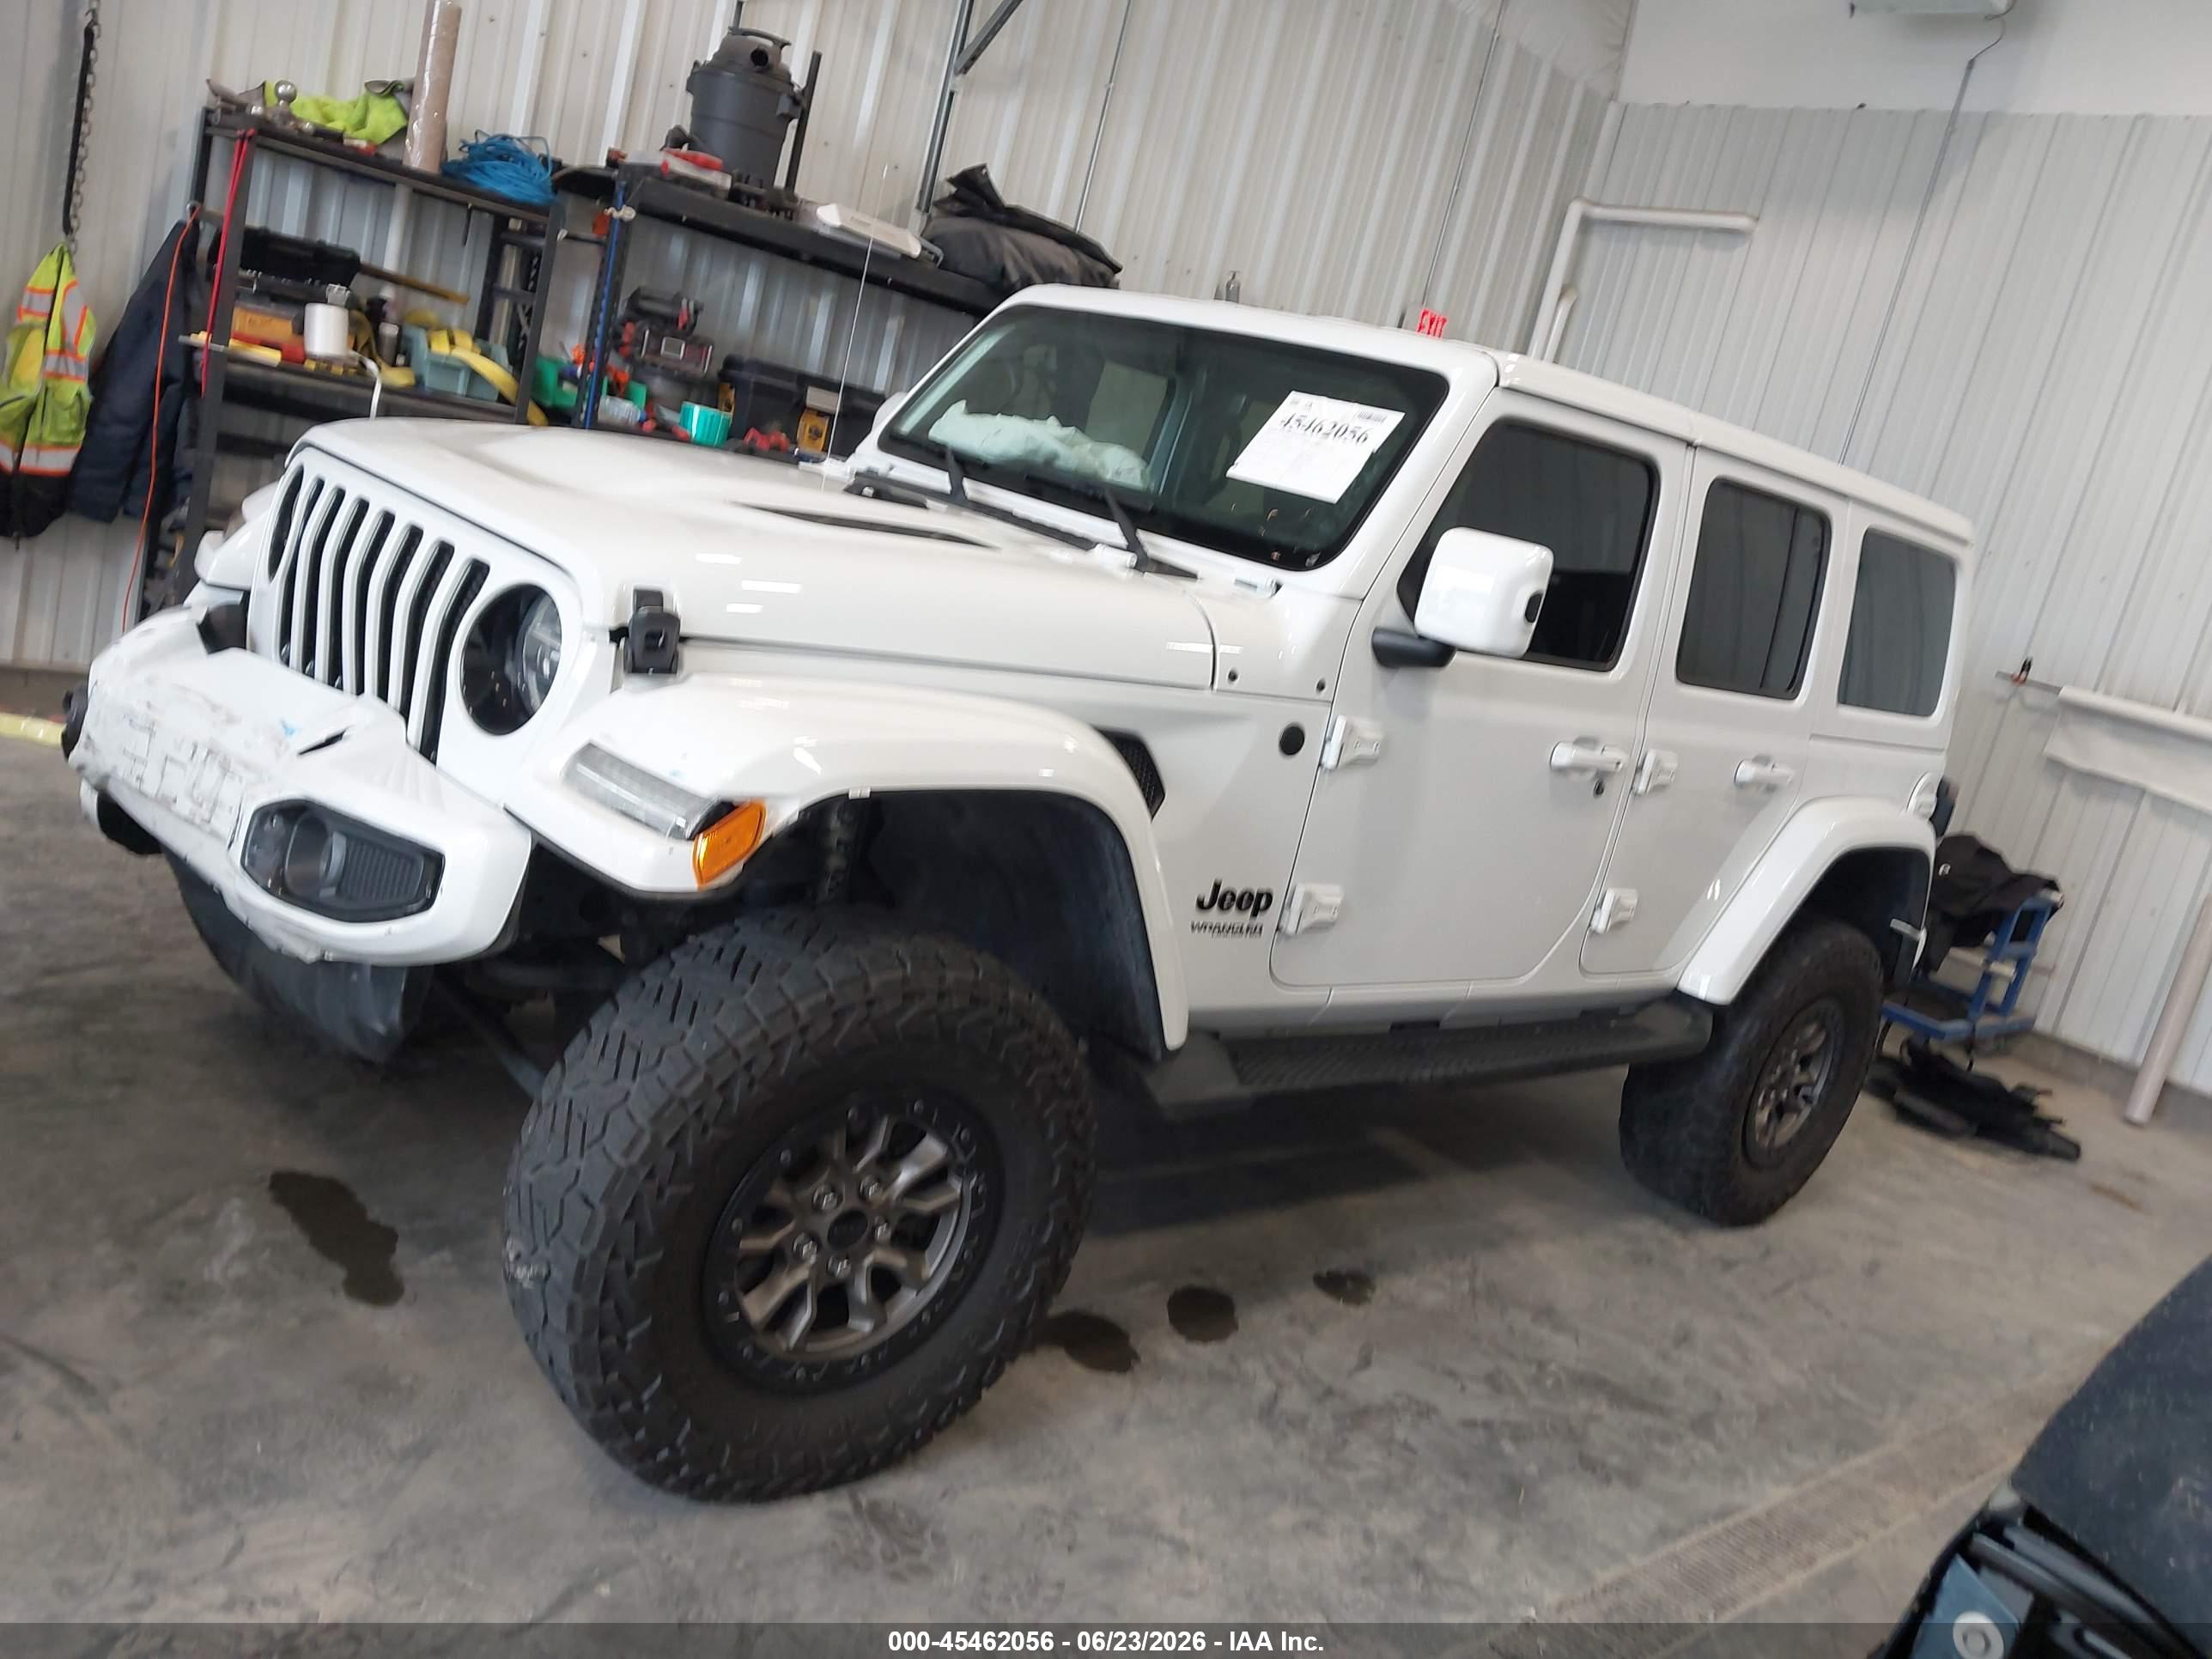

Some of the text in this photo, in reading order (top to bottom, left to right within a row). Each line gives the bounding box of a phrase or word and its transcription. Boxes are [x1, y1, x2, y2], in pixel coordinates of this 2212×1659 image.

[1416, 308, 1447, 338] EXIT
[1280, 413, 1370, 445] 45462056
[1195, 878, 1274, 920] Jeep
